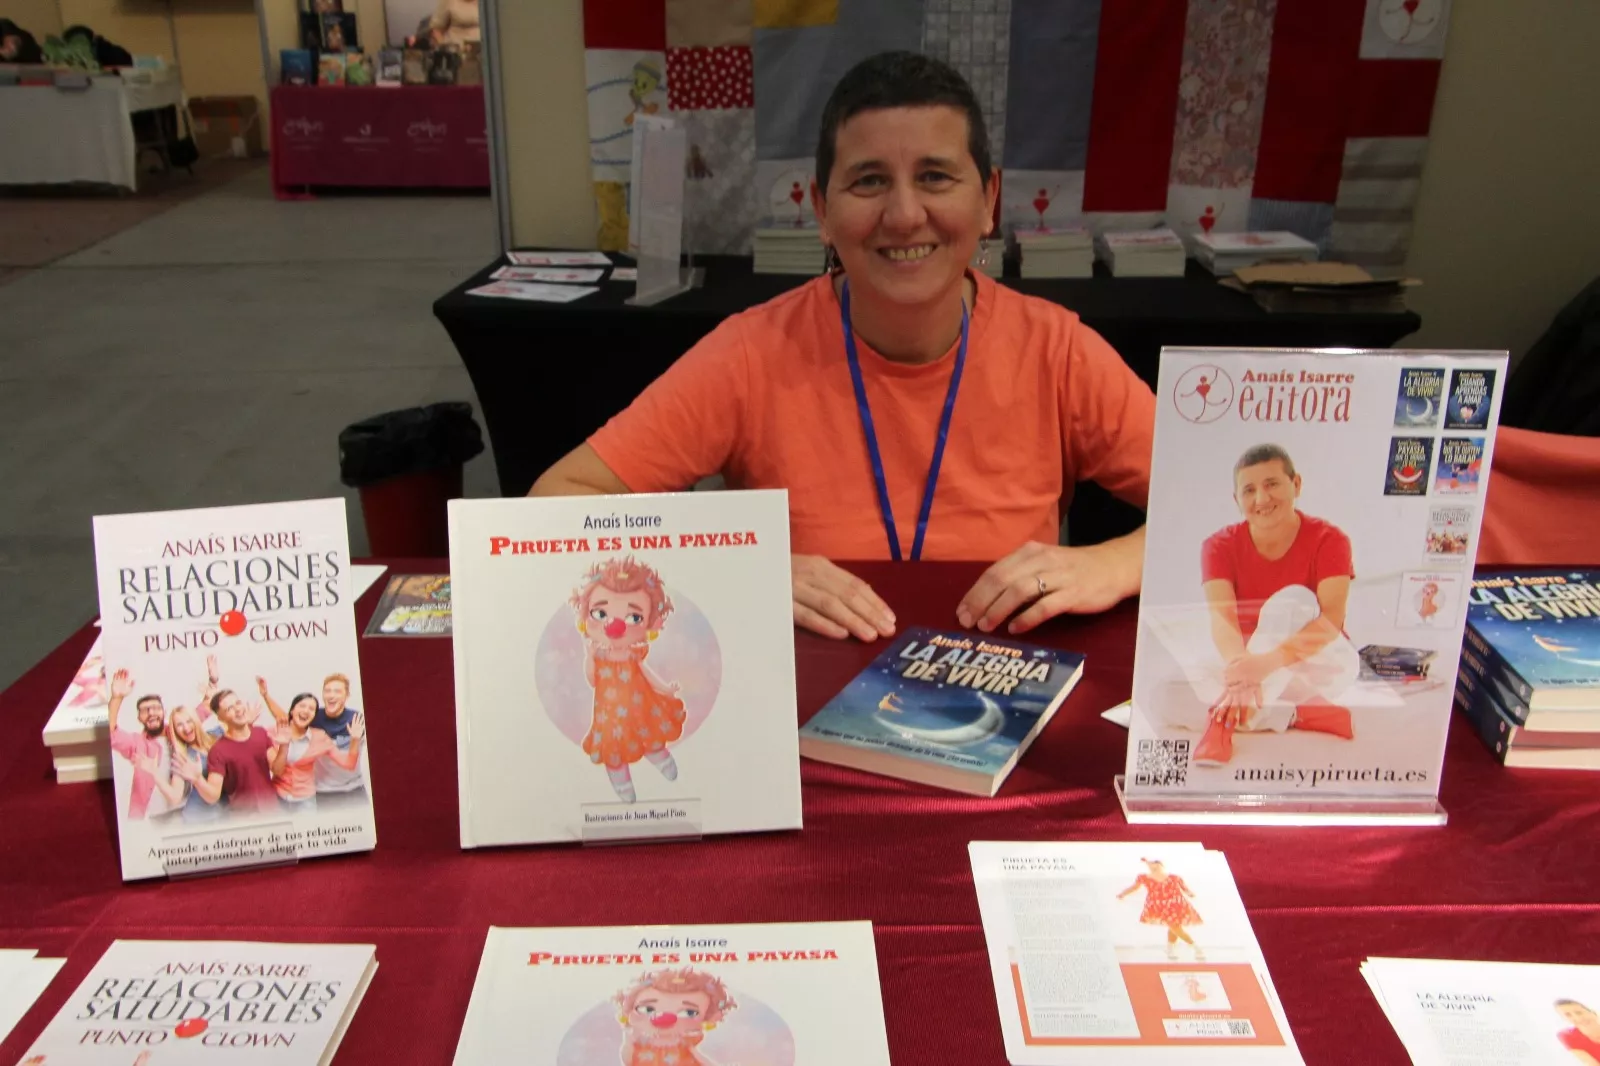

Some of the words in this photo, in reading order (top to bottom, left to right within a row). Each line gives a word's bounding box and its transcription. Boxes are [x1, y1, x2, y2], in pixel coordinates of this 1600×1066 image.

[1242, 369, 1294, 383] Anaís
[1300, 370, 1355, 384] Isarre
[1239, 385, 1351, 422] editora
[584, 512, 621, 530] Anaís
[624, 514, 662, 528] Isarre
[162, 533, 225, 558] ANAÍS
[233, 531, 302, 553] ISARRE
[490, 536, 590, 556] PIRUETA
[598, 536, 622, 551] ES
[630, 535, 672, 550] UNA
[679, 532, 758, 548] PAYASA
[119, 551, 340, 595] RELACIONES
[123, 579, 340, 624] SALUDABLES
[1503, 580, 1600, 604] ALEGRÍ
[1494, 602, 1542, 621] DE
[144, 628, 219, 653] PUNTO
[250, 620, 328, 644] CLOWN
[929, 634, 974, 649] Anaís
[976, 640, 1023, 658] Isarre
[900, 641, 938, 662] LA
[937, 648, 1050, 682] ALEGRÍA
[902, 660, 942, 682] DE
[946, 664, 1020, 696] VIVIR
[1234, 763, 1428, 787] anaisypirueta.es
[624, 812, 632, 821] de
[634, 810, 648, 820] Juan
[650, 808, 669, 820] Miguel
[148, 843, 198, 860] Aprende
[203, 844, 209, 852] a
[213, 836, 264, 851] disfrutar
[268, 833, 281, 844] de
[286, 831, 302, 842] tus
[306, 824, 363, 838] relaciones
[166, 848, 255, 867] interpersonales
[259, 848, 265, 858] y
[270, 842, 304, 856] alegra
[308, 838, 319, 849] tu
[324, 836, 348, 846] vida
[638, 936, 680, 949] Anaís
[685, 937, 728, 948] Isarre
[154, 960, 226, 977] ANAÍS
[232, 962, 312, 978] ISARRE
[527, 952, 642, 966] PIRUETA
[652, 952, 680, 964] ES
[689, 952, 739, 964] UNA
[747, 950, 839, 962] PAYASA
[93, 978, 342, 1002] RELACIONES
[76, 1000, 328, 1024] SALUDABLES
[79, 1029, 168, 1045] PUNTO
[202, 1030, 296, 1048] CLOWN
